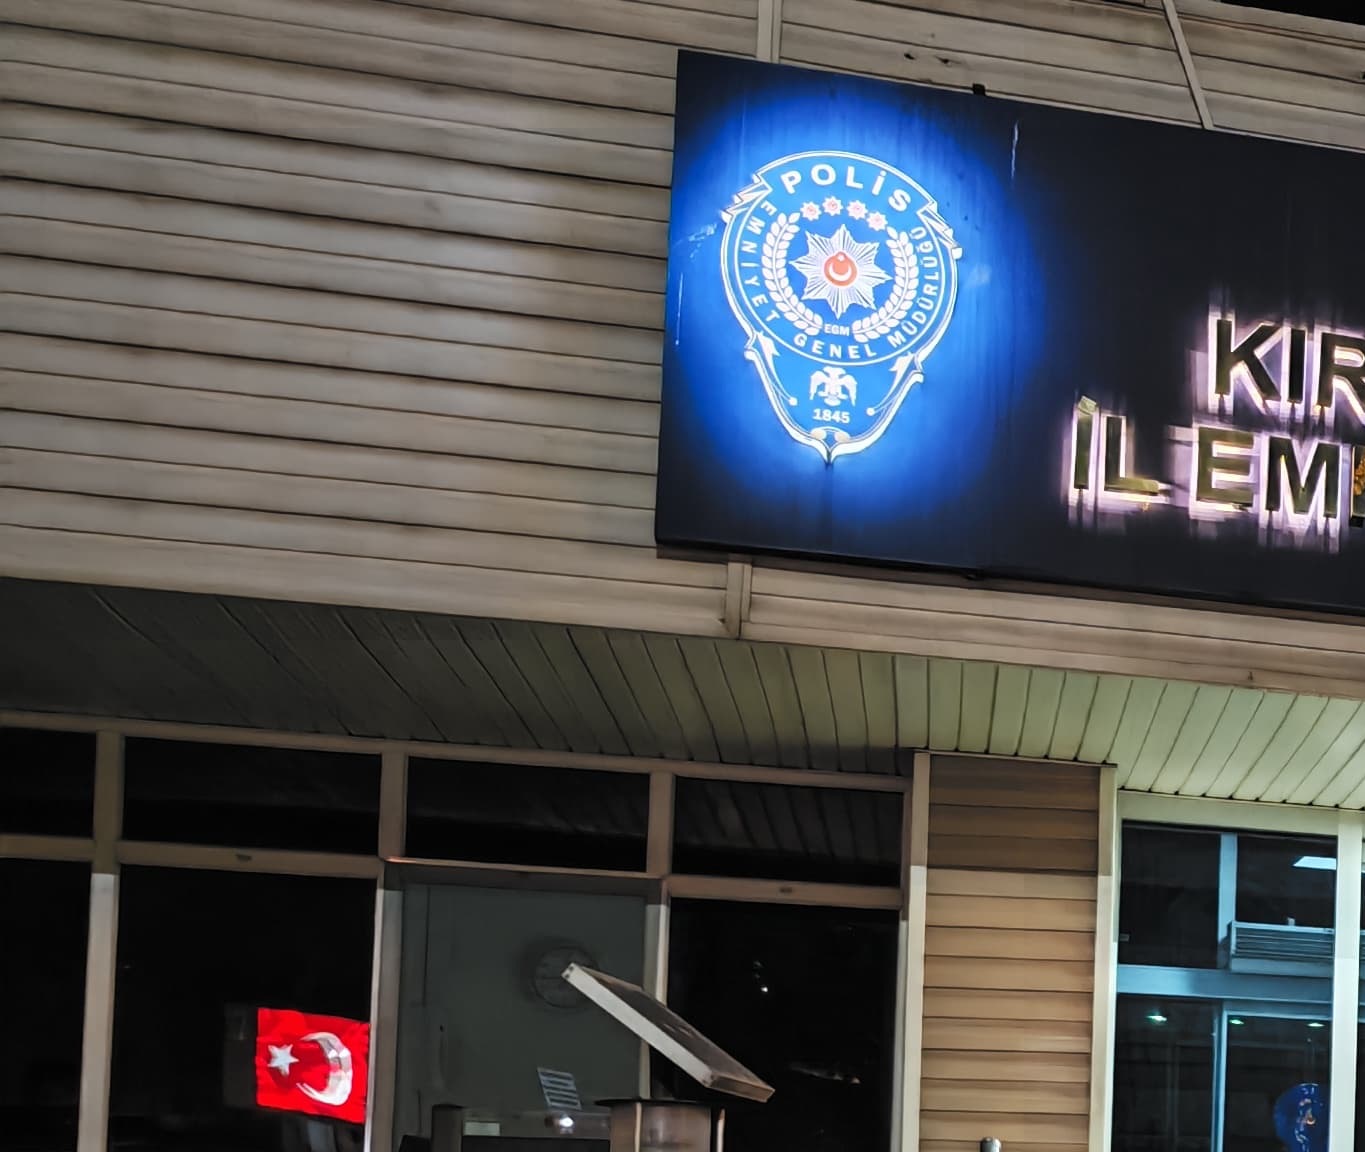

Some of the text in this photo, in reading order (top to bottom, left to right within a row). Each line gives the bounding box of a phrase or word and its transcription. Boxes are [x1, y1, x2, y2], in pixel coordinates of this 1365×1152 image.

[780, 163, 911, 212] POLİS
[793, 333, 877, 359] GENEL
[886, 226, 939, 349] MÜDÜRLÜĞÜ
[823, 323, 850, 337] EGM
[812, 408, 850, 424] 1845
[1071, 394, 1163, 500] İL
